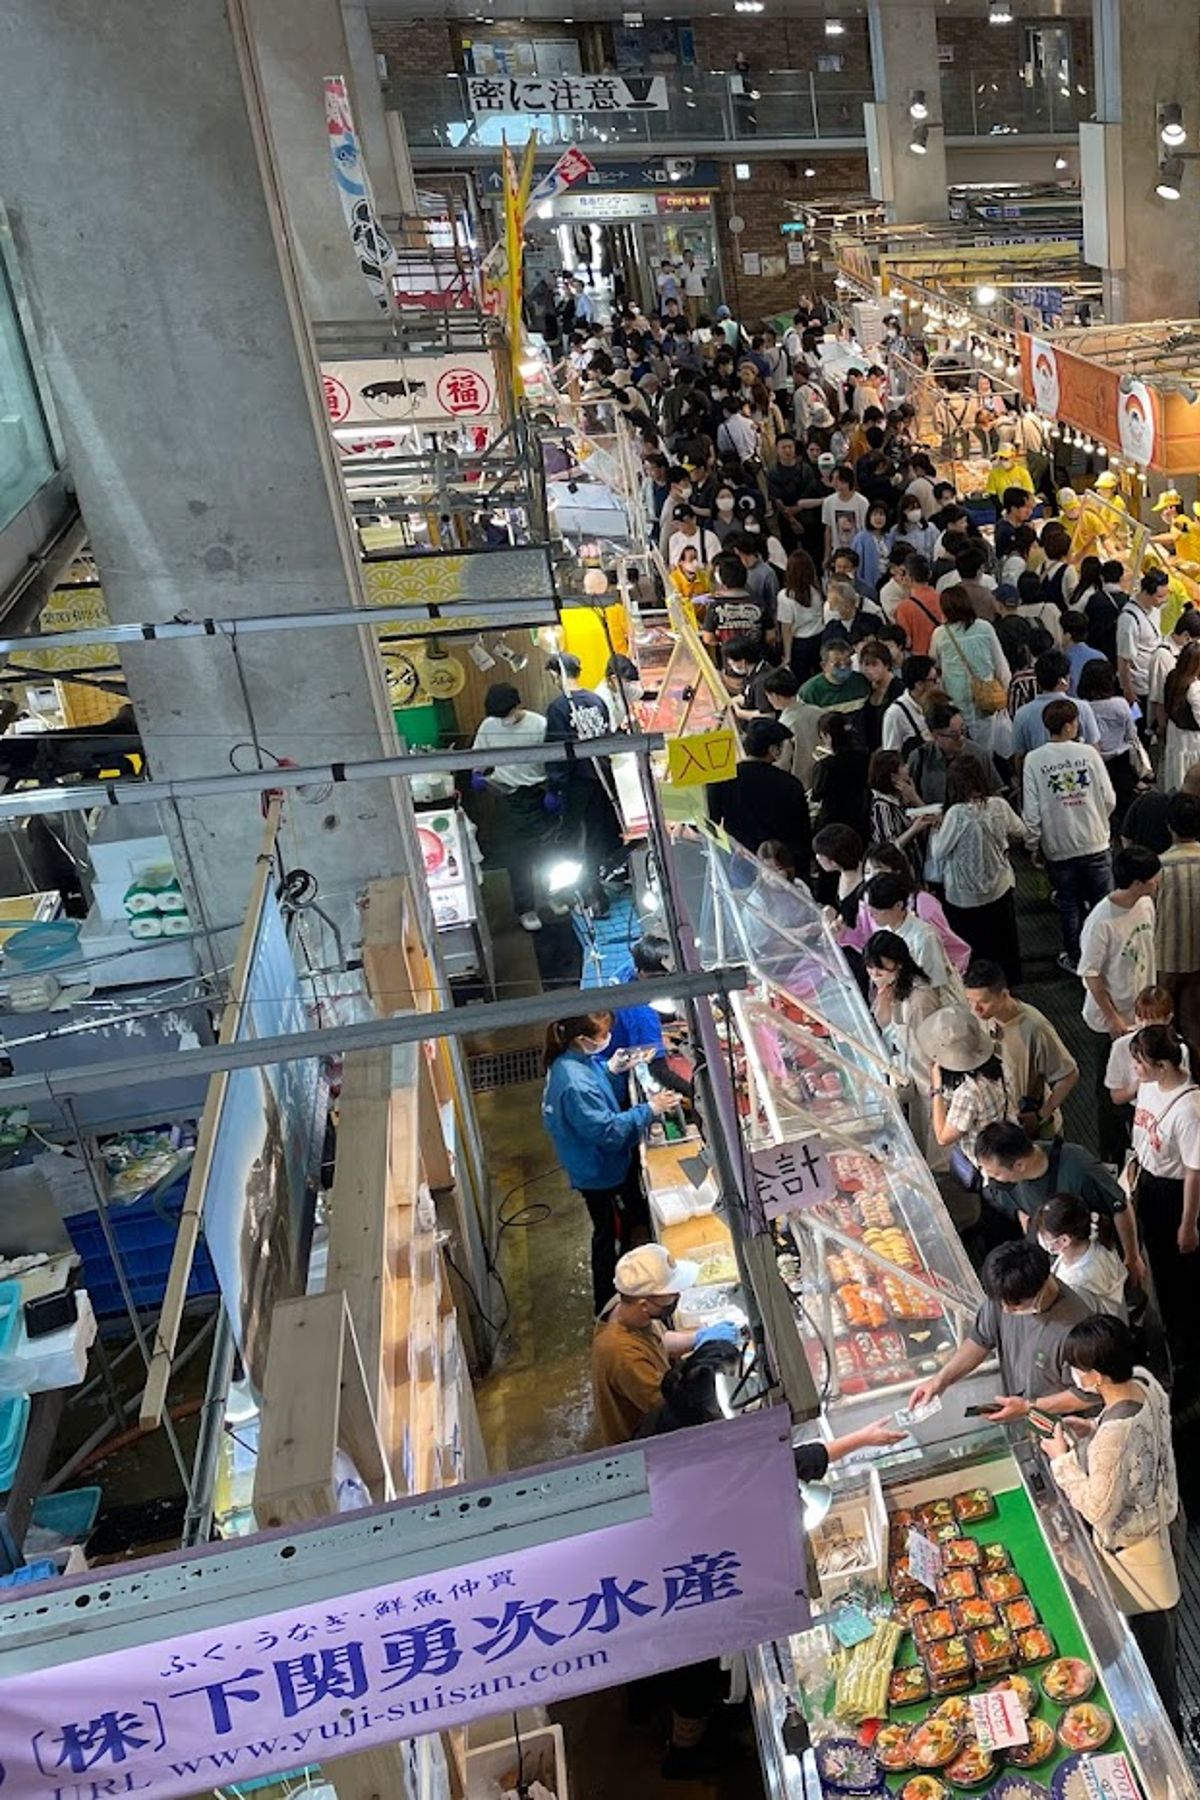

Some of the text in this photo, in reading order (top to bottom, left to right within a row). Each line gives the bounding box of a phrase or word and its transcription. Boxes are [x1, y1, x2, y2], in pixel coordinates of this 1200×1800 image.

[679, 737, 732, 780] 入口
[47, 1650, 610, 1800] URL www.yuji-suisan.com
